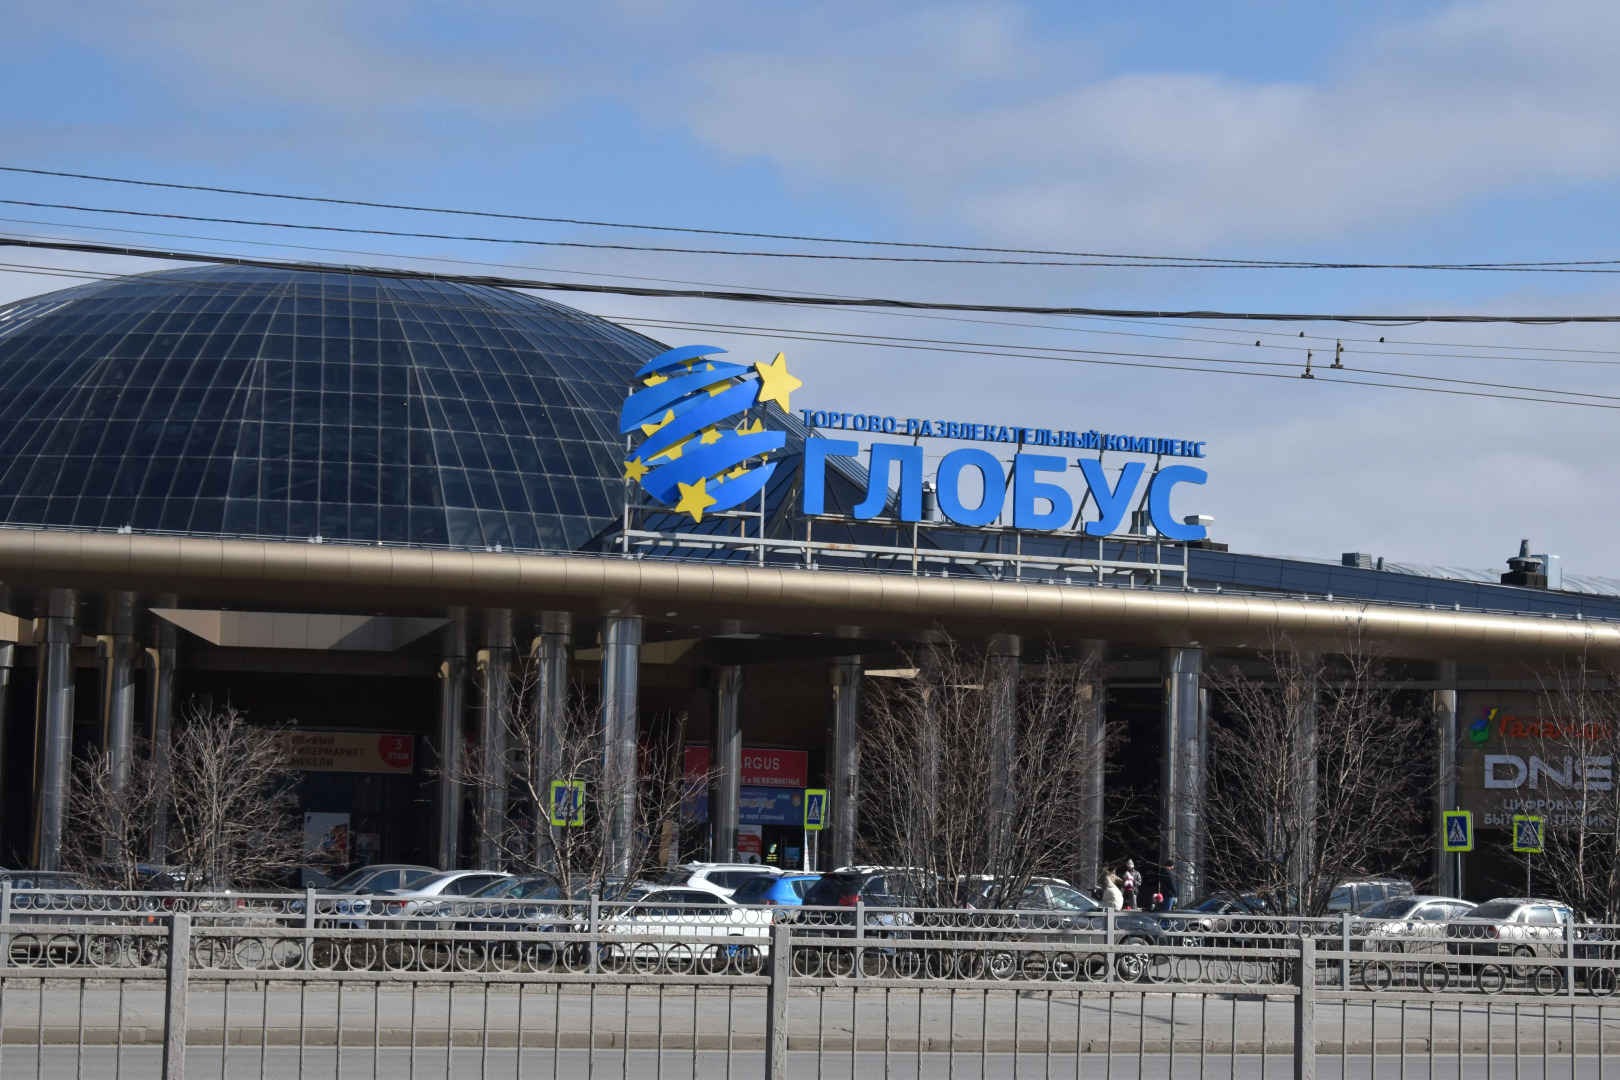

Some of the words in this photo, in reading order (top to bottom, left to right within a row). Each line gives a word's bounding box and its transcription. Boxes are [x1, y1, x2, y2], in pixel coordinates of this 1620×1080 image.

[801, 408, 1101, 450] ТОРГОВО-РАЗВЛЕКАТЕЛЬНЫЙ
[1104, 433, 1207, 458] КОМПЛЕКС
[803, 438, 1208, 541] ГЛОБУС
[292, 735, 334, 745] ПЕРВЫЙ
[395, 738, 402, 749] 3
[292, 757, 334, 767] МЕБЕЛИ
[387, 752, 409, 761] ЭТАЖ
[741, 756, 780, 770] RGUS
[1484, 754, 1613, 791] DNS
